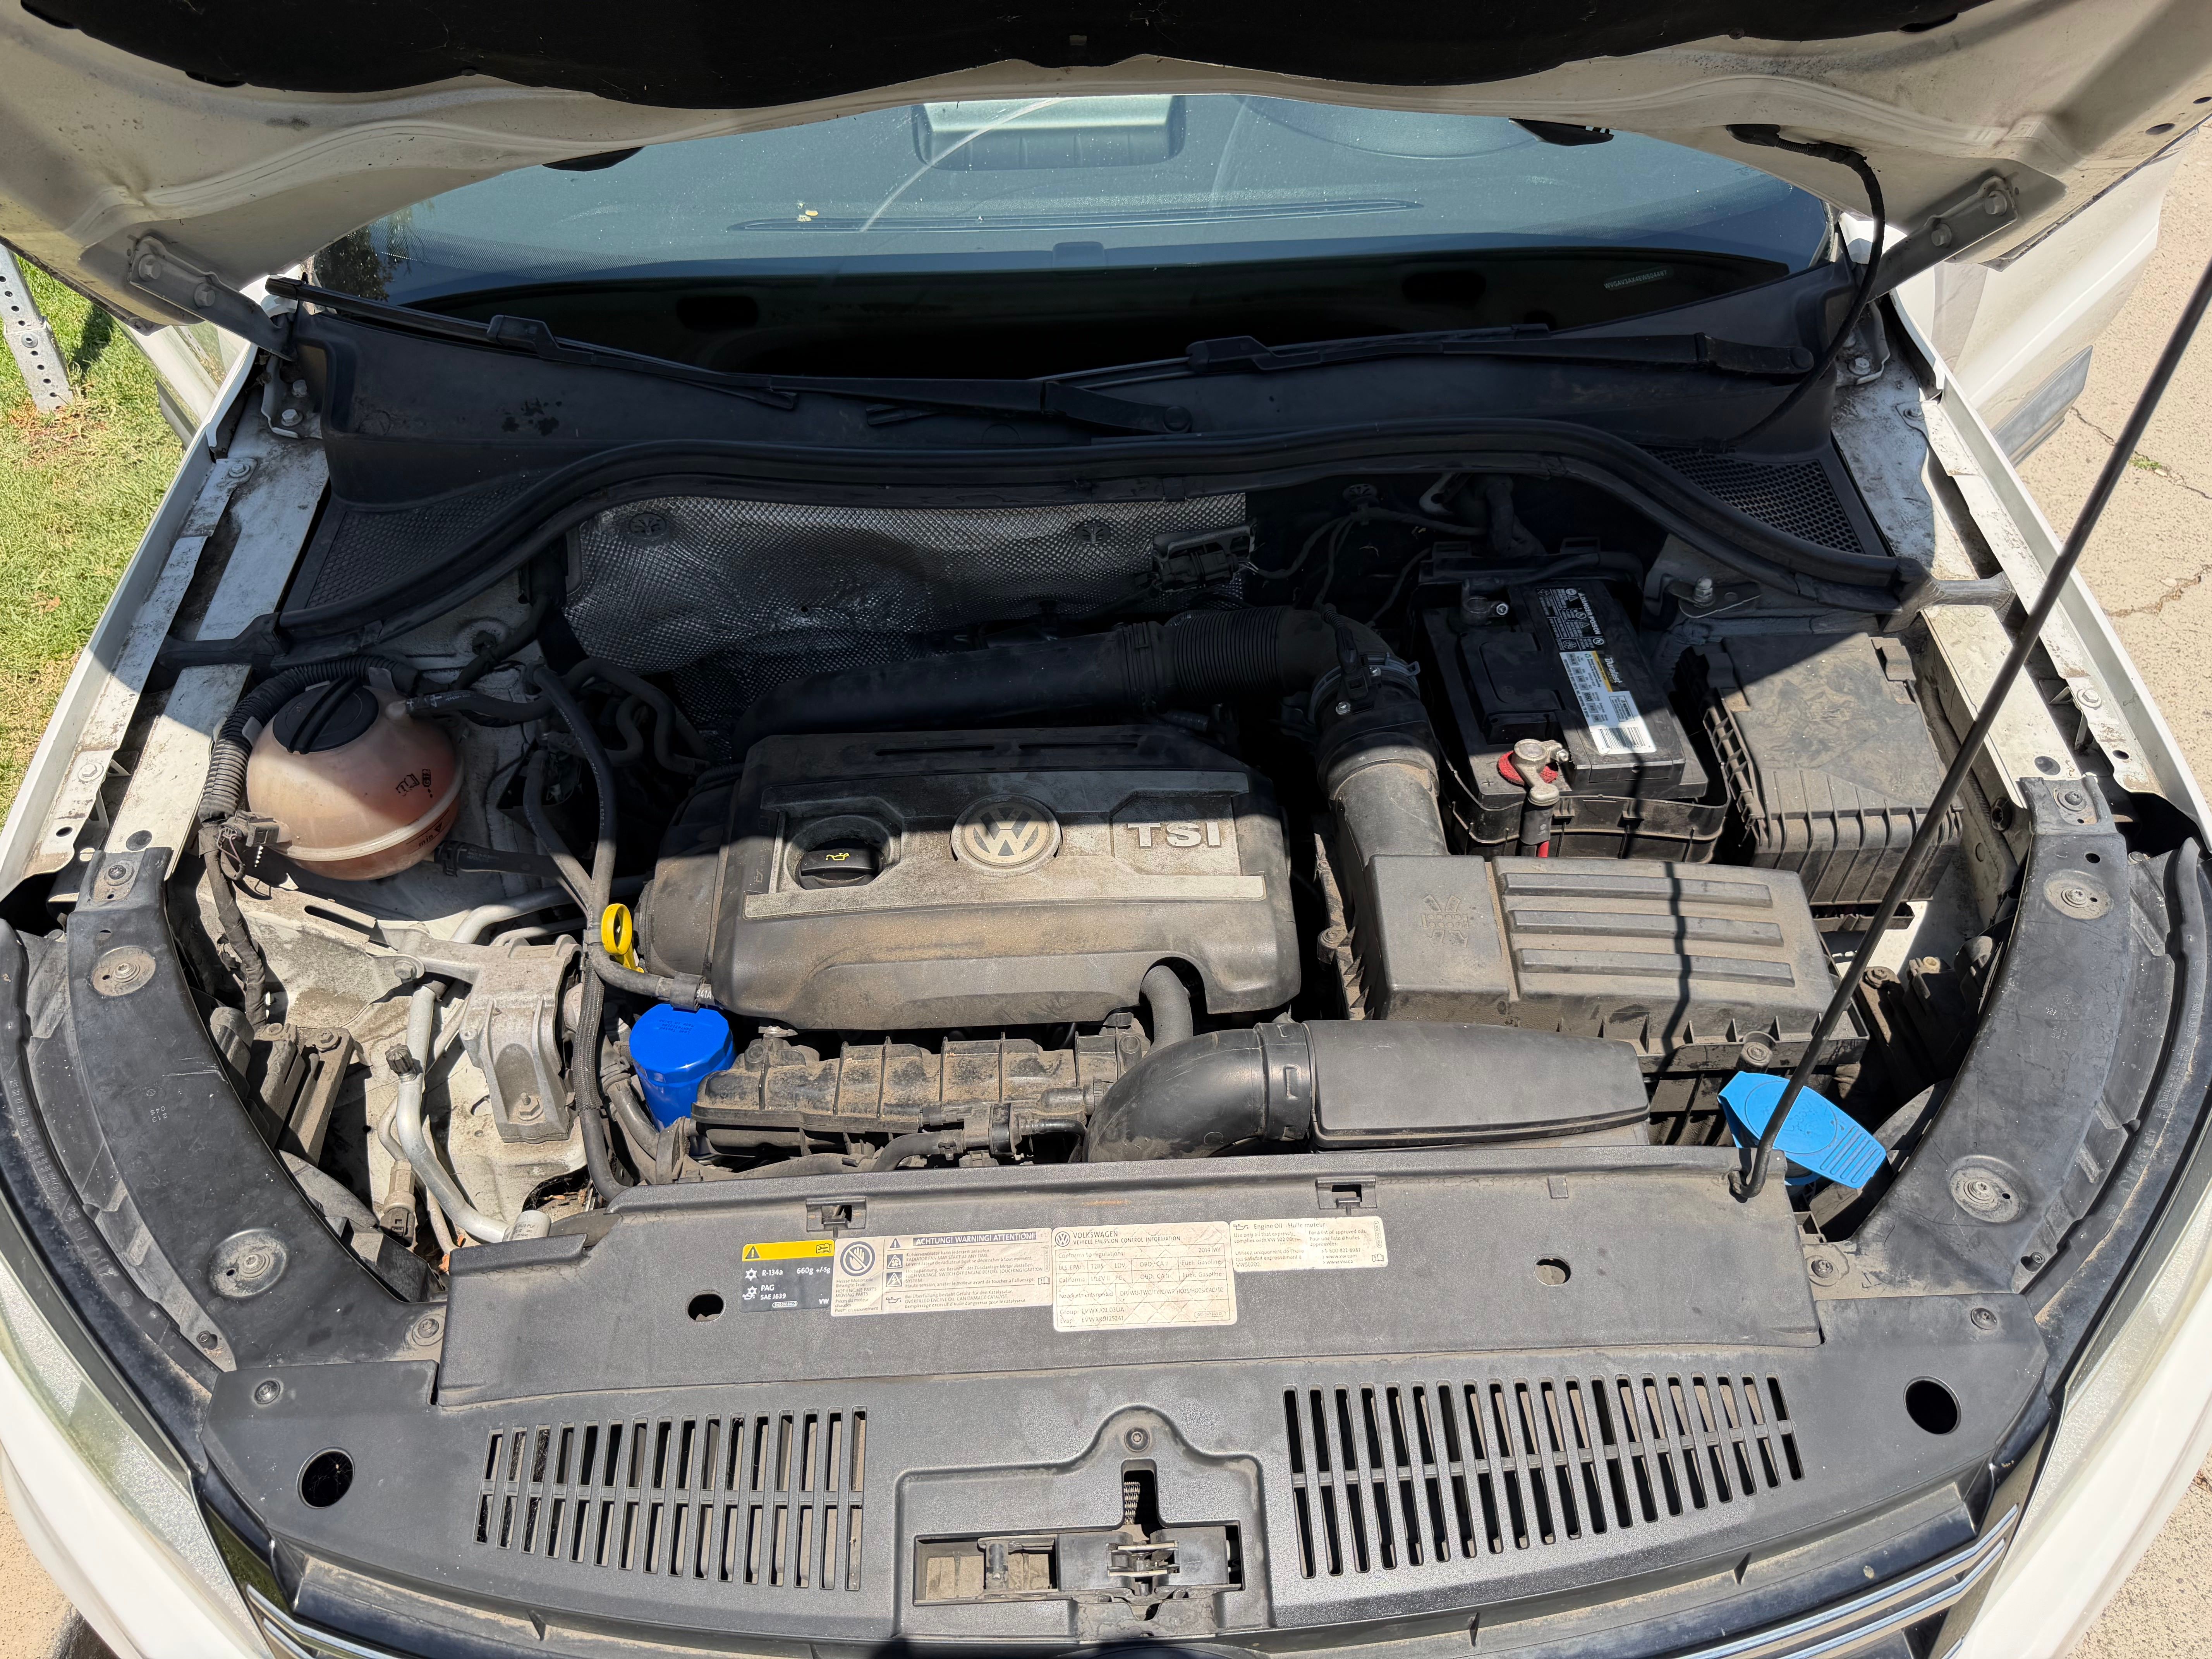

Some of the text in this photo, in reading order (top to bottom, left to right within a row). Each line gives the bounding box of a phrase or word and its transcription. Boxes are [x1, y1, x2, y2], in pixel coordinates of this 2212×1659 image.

[1604, 657, 1623, 684] Duralast
[418, 834, 433, 847] min
[1127, 822, 1221, 848] TSI
[915, 1232, 1034, 1245] ACHTUNG! WARNING! ATTENTION!
